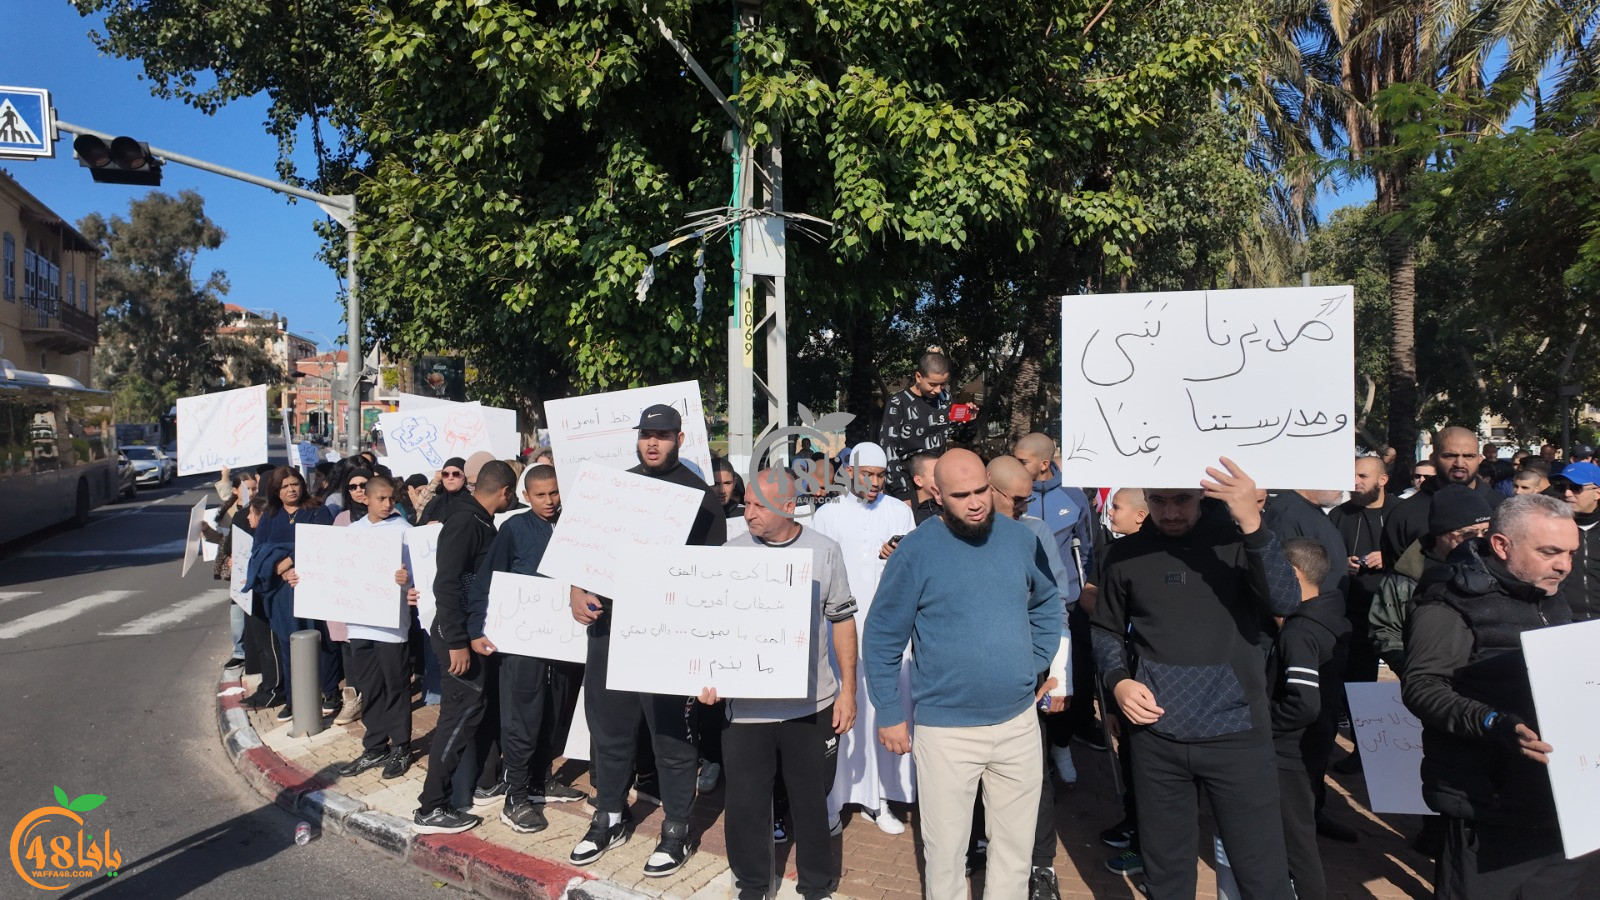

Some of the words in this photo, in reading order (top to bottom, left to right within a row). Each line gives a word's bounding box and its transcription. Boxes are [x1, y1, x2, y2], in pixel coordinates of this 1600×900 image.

[744, 287, 753, 356] 10069
[1185, 387, 1348, 447] ومدرستنا
[668, 564, 697, 577] الحق
[665, 592, 675, 605] !!!
[689, 659, 701, 675] !!!
[757, 654, 774, 674] ما
